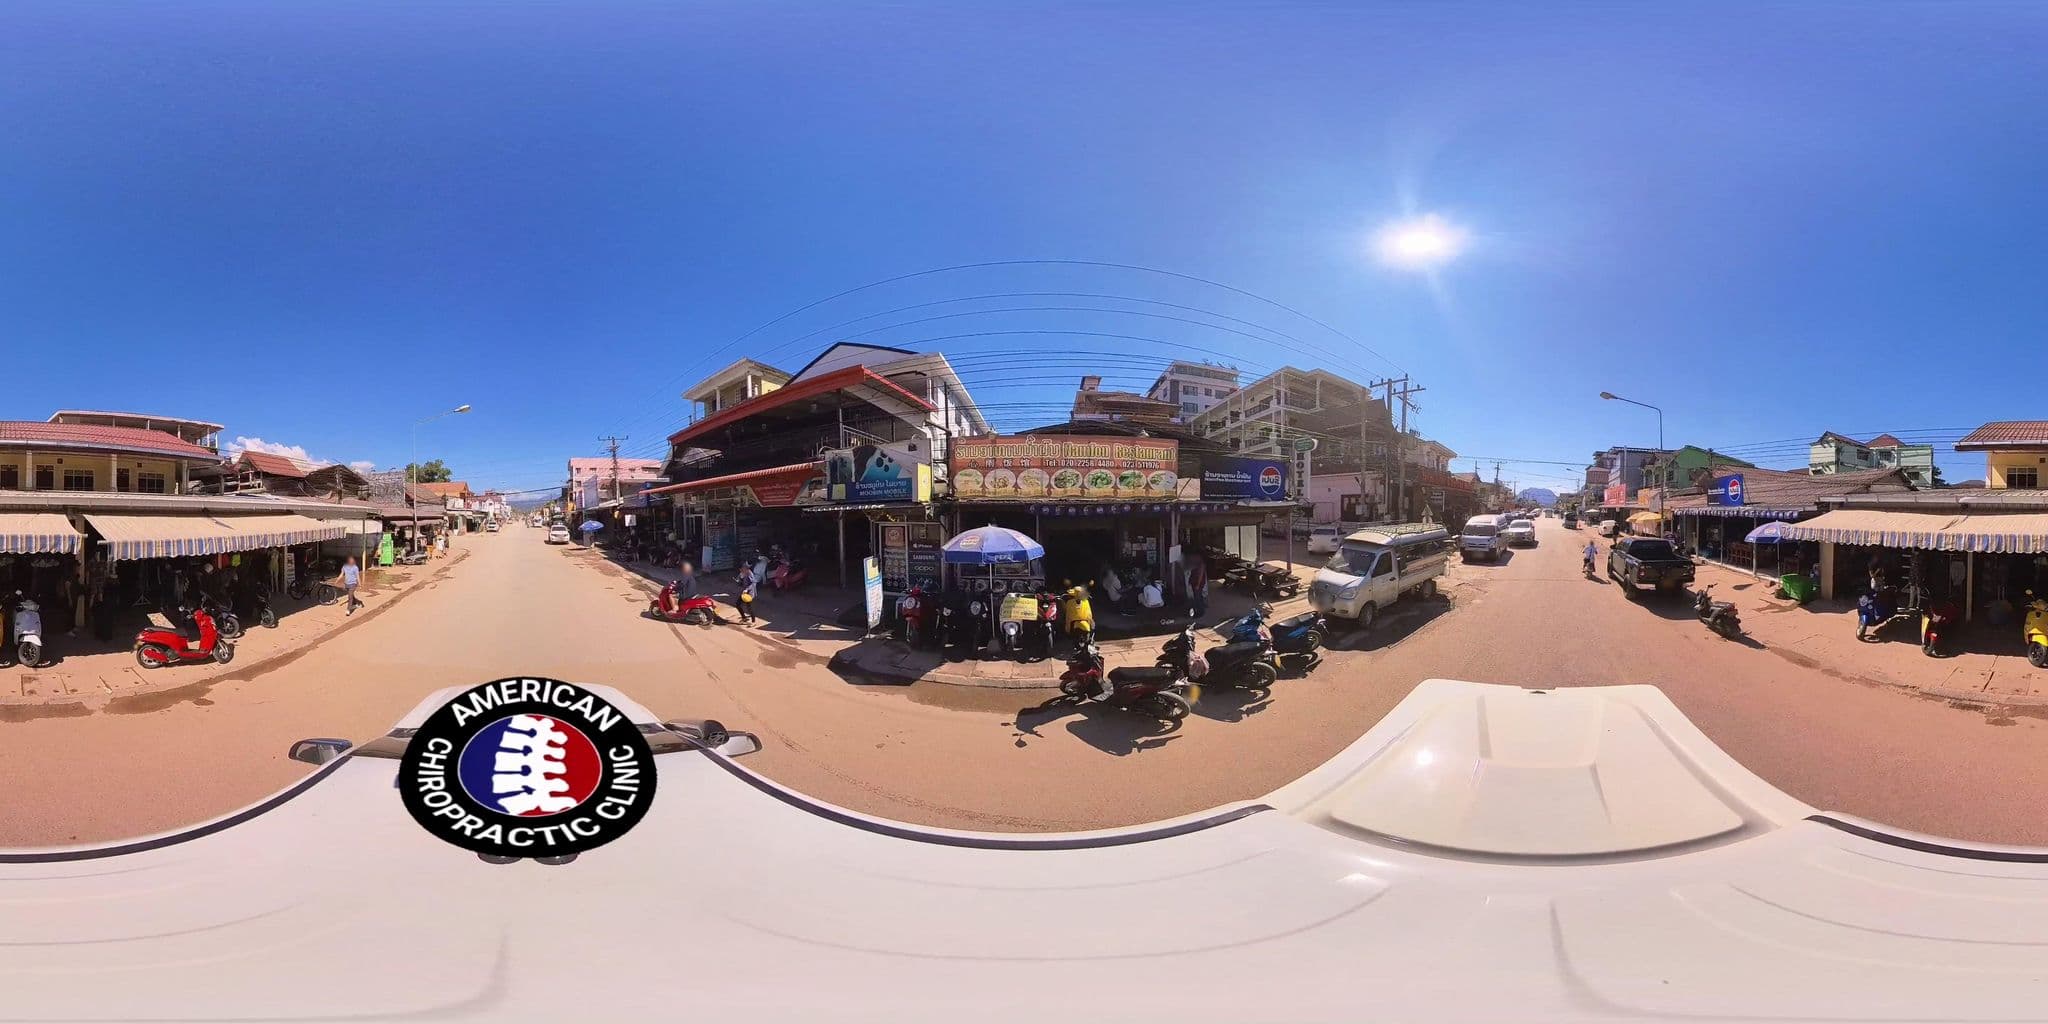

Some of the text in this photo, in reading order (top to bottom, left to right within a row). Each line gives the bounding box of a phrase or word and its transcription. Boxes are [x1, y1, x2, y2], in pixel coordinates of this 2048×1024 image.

[1063, 442, 1110, 459] Namfon
[1113, 443, 1176, 461] Restaurant
[1061, 459, 1074, 467] 020
[1122, 460, 1135, 468] 023
[1296, 452, 1305, 497] HOTEL
